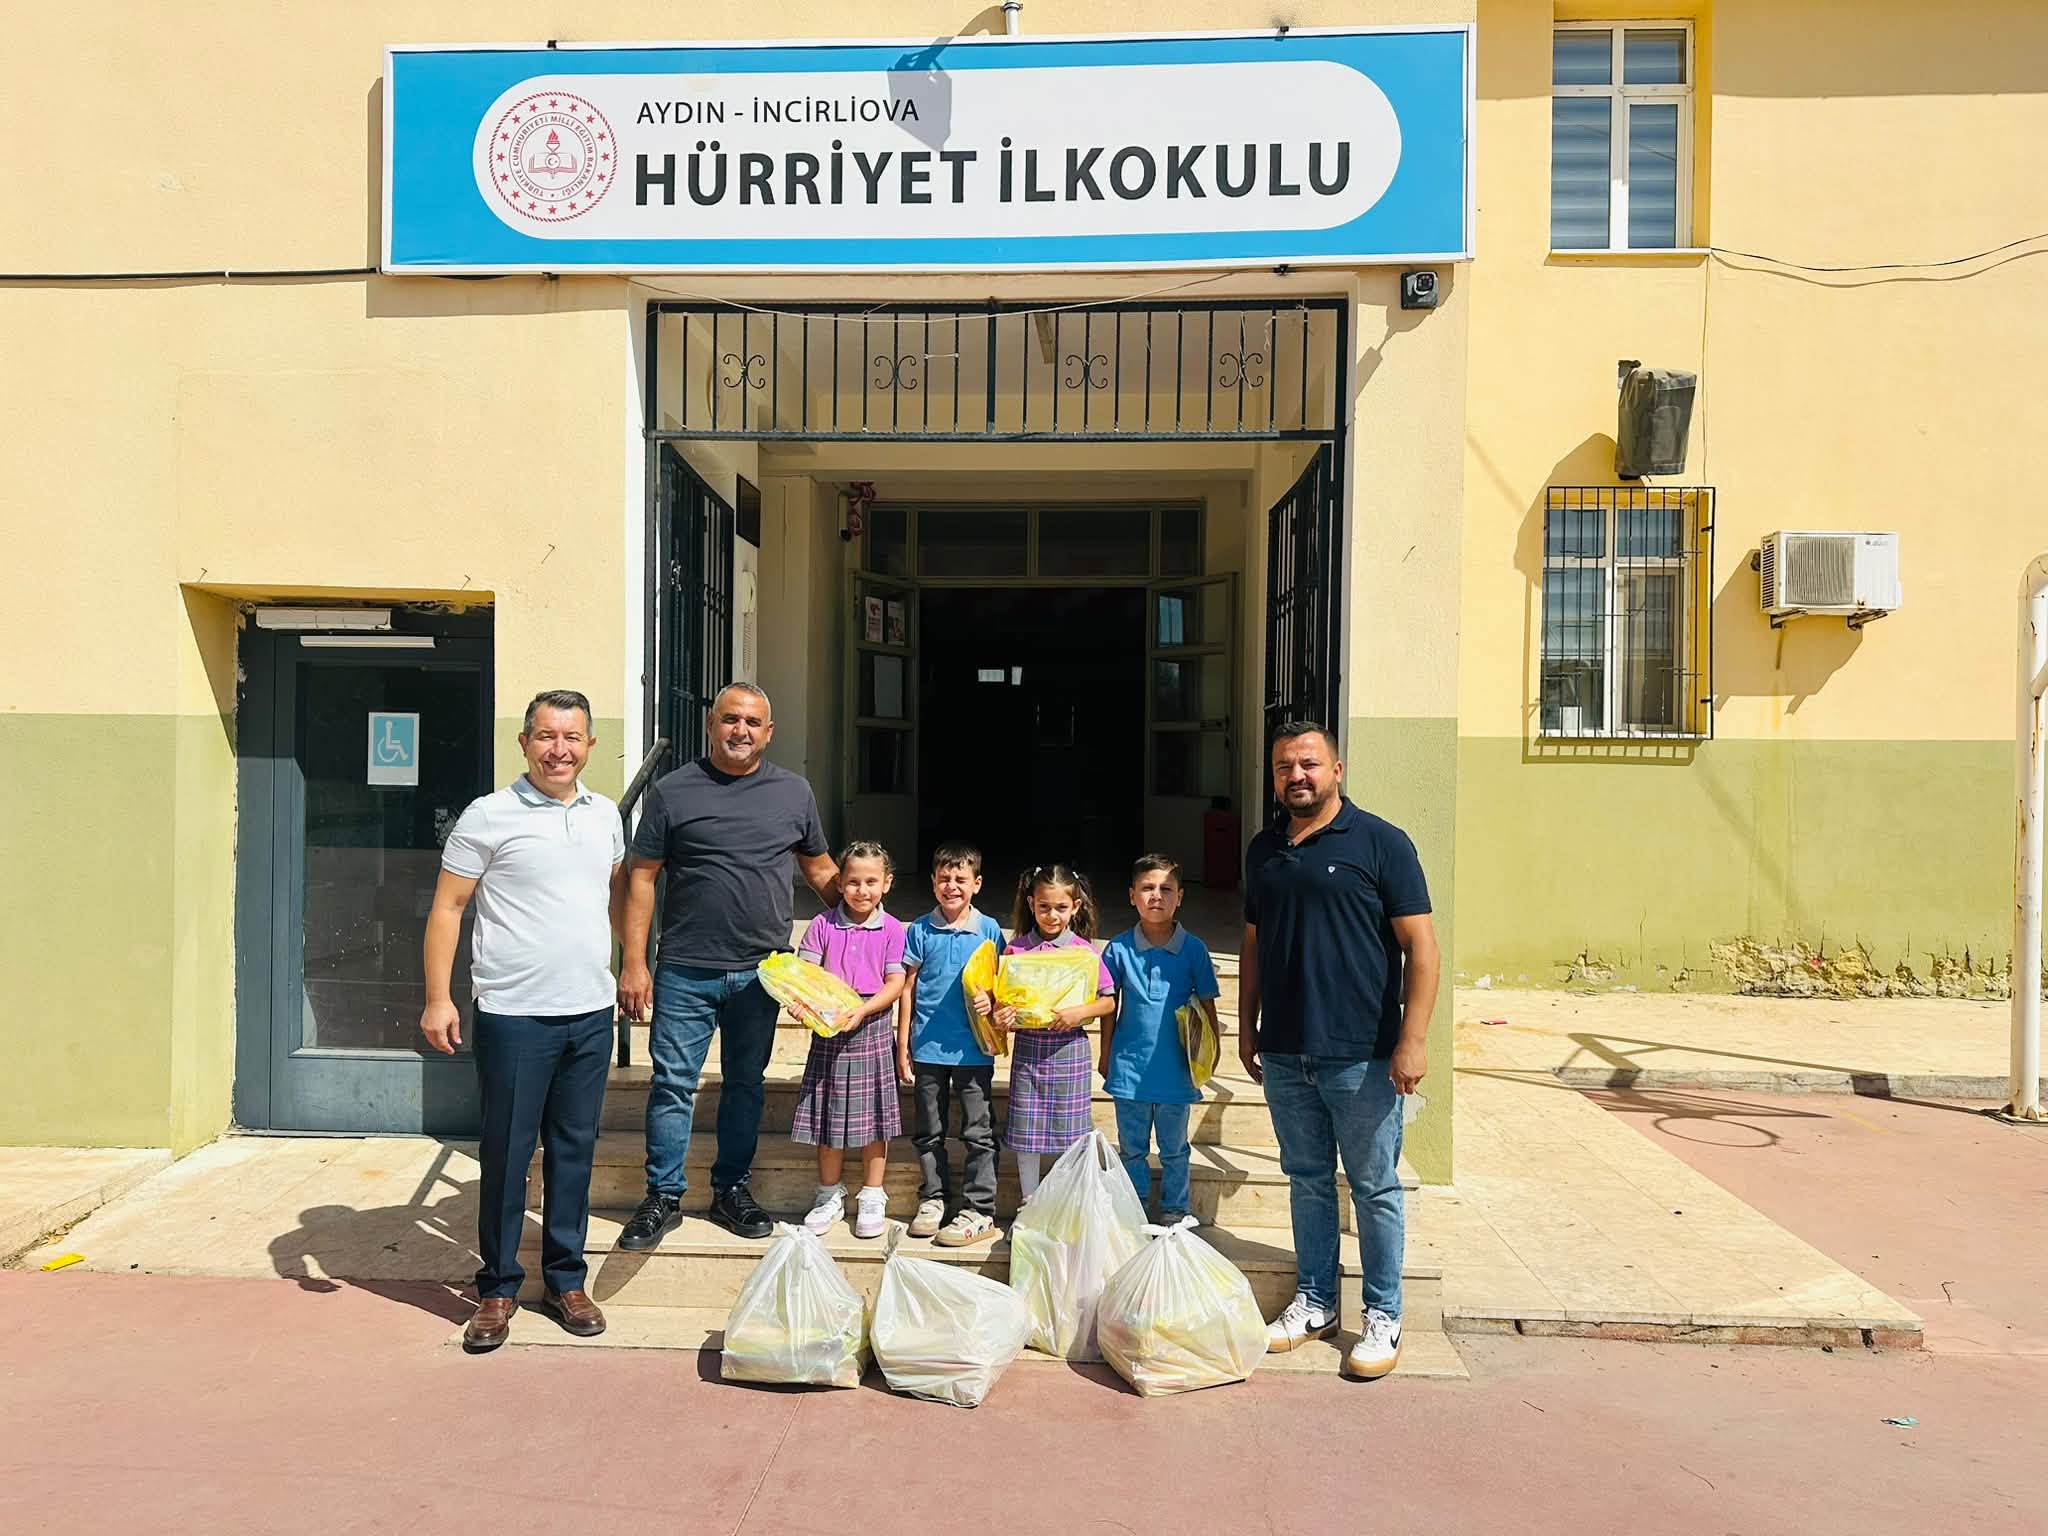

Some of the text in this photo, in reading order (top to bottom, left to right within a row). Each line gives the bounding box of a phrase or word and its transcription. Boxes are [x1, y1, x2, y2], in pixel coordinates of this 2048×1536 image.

[636, 101, 724, 124] AYDIN
[754, 96, 920, 123] İNCİRLİOVA
[635, 137, 1350, 206] HÜRRİYET İLKOKULU
